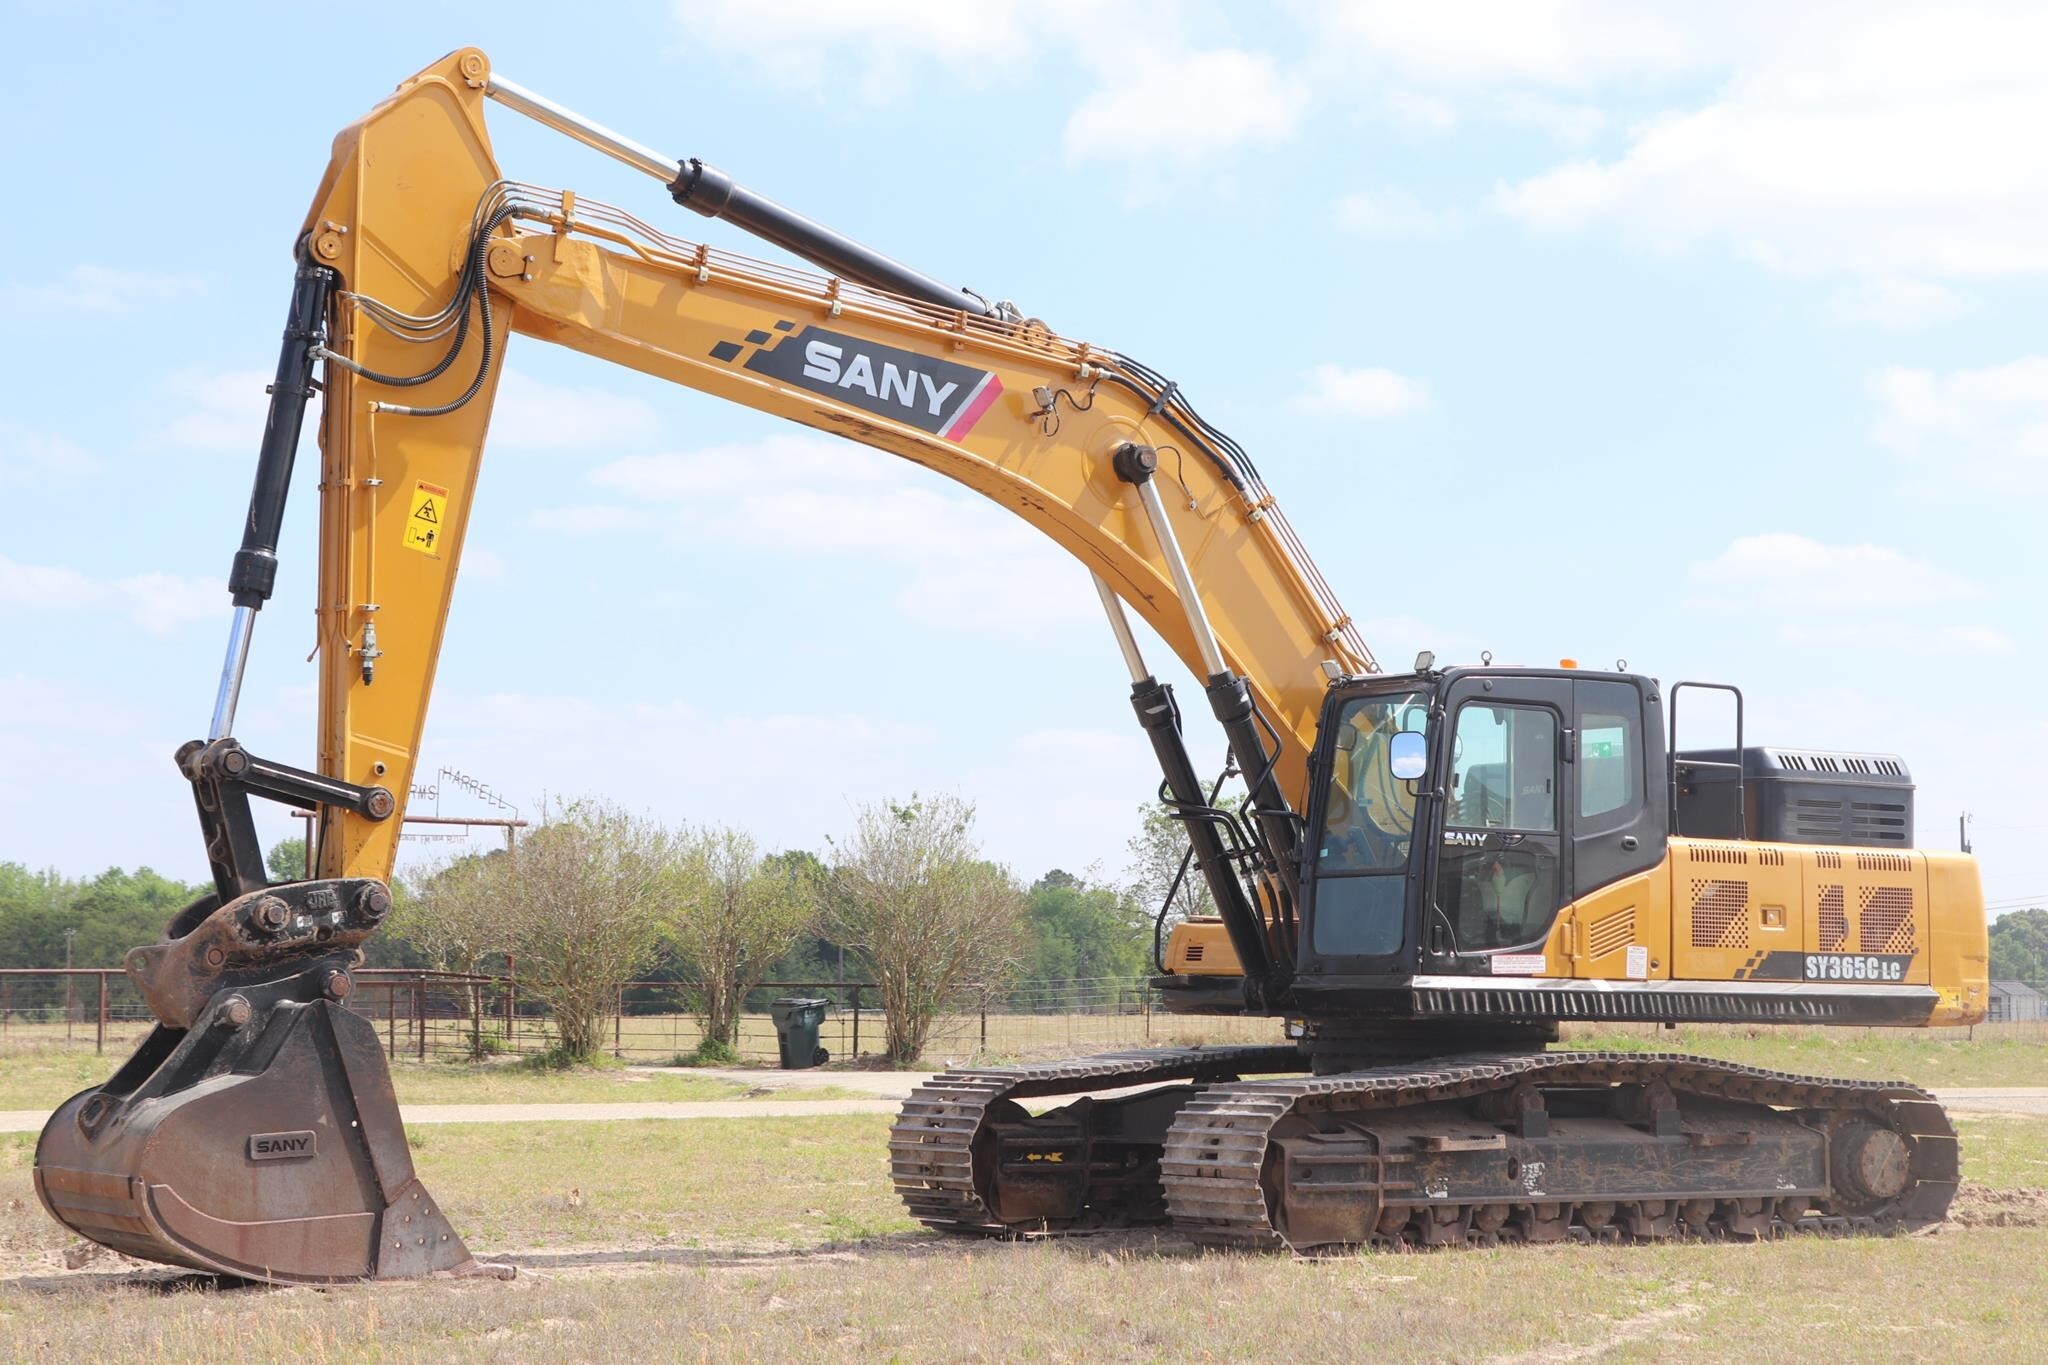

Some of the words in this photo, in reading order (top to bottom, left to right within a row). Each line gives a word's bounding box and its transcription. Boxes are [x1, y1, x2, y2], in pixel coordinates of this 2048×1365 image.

[803, 340, 958, 416] SANY
[442, 766, 506, 809] HARRELL
[1444, 832, 1488, 846] SANY
[1882, 961, 1901, 980] LC
[256, 1138, 309, 1153] SANY
